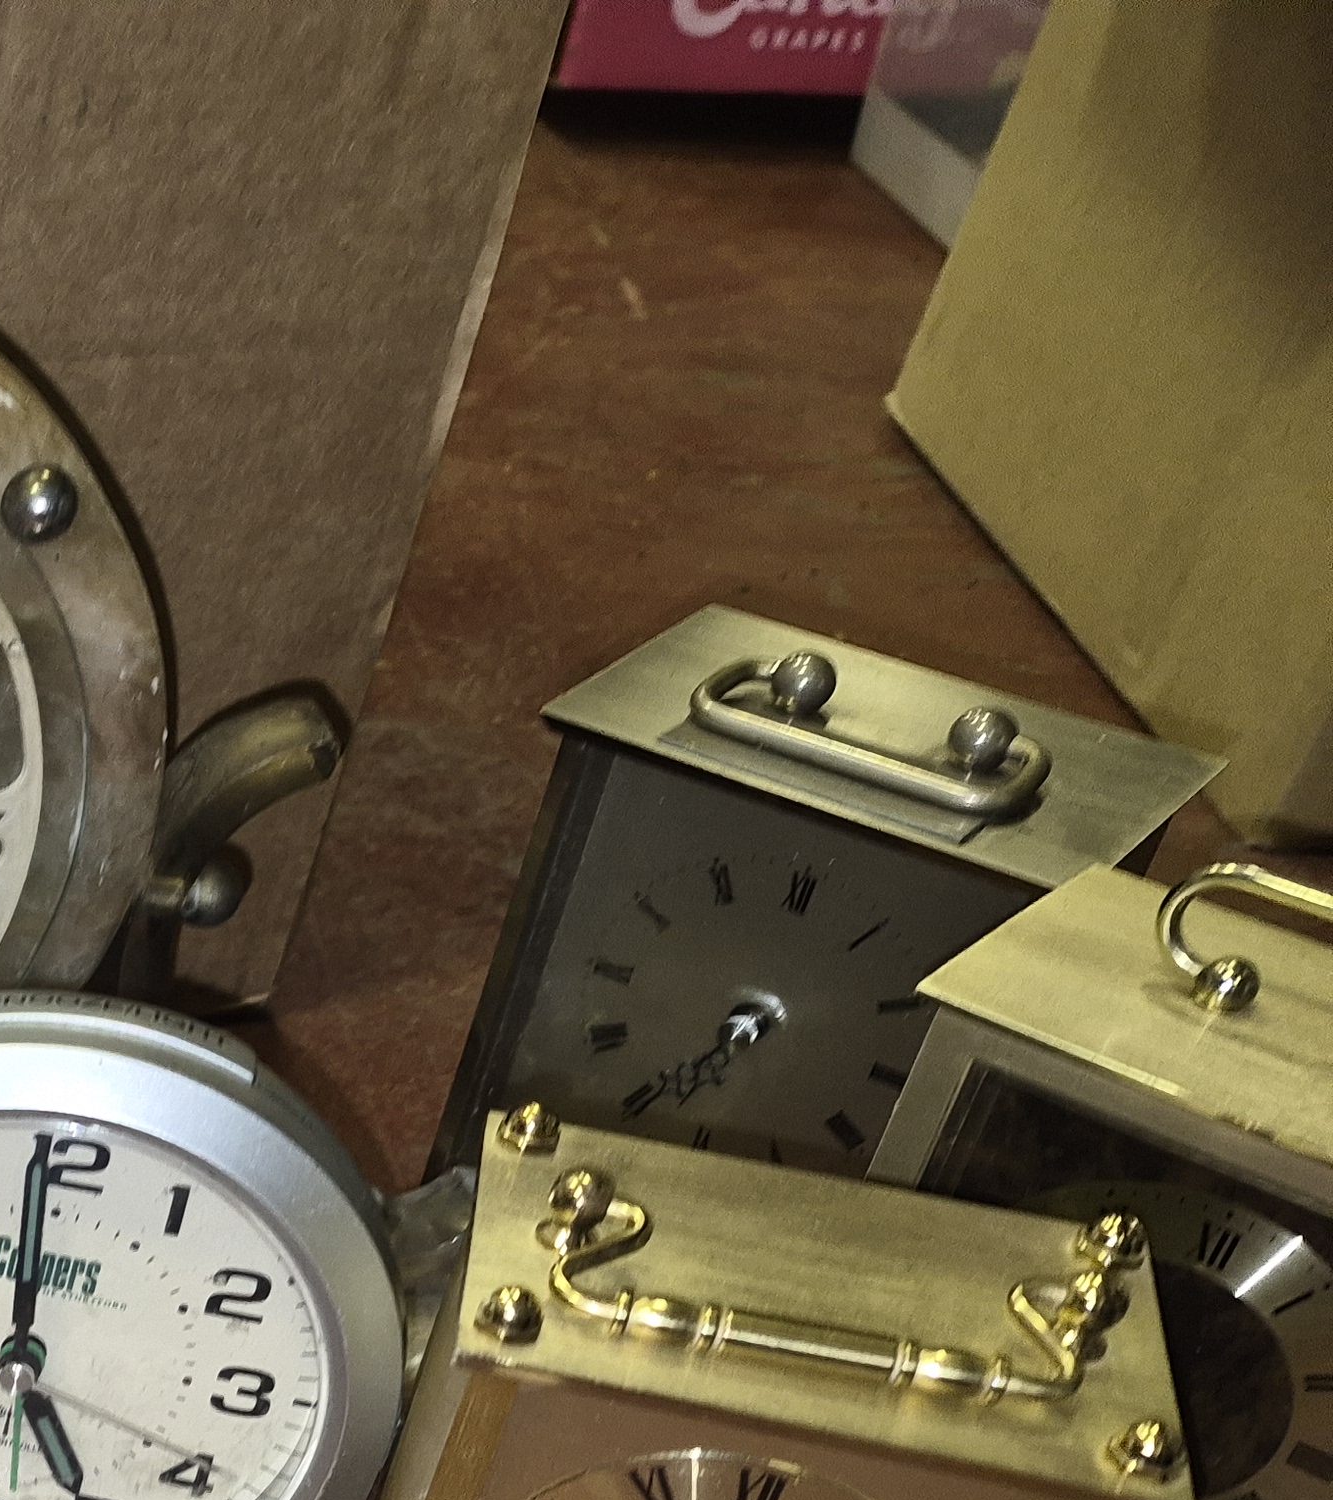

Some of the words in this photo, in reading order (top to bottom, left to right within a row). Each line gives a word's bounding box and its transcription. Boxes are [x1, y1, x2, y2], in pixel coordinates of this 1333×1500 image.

[31, 1133, 111, 1195] 12
[164, 1185, 191, 1236] 1
[204, 1267, 273, 1324] 2
[210, 1366, 276, 1418] 3
[158, 1454, 215, 1499] 4
